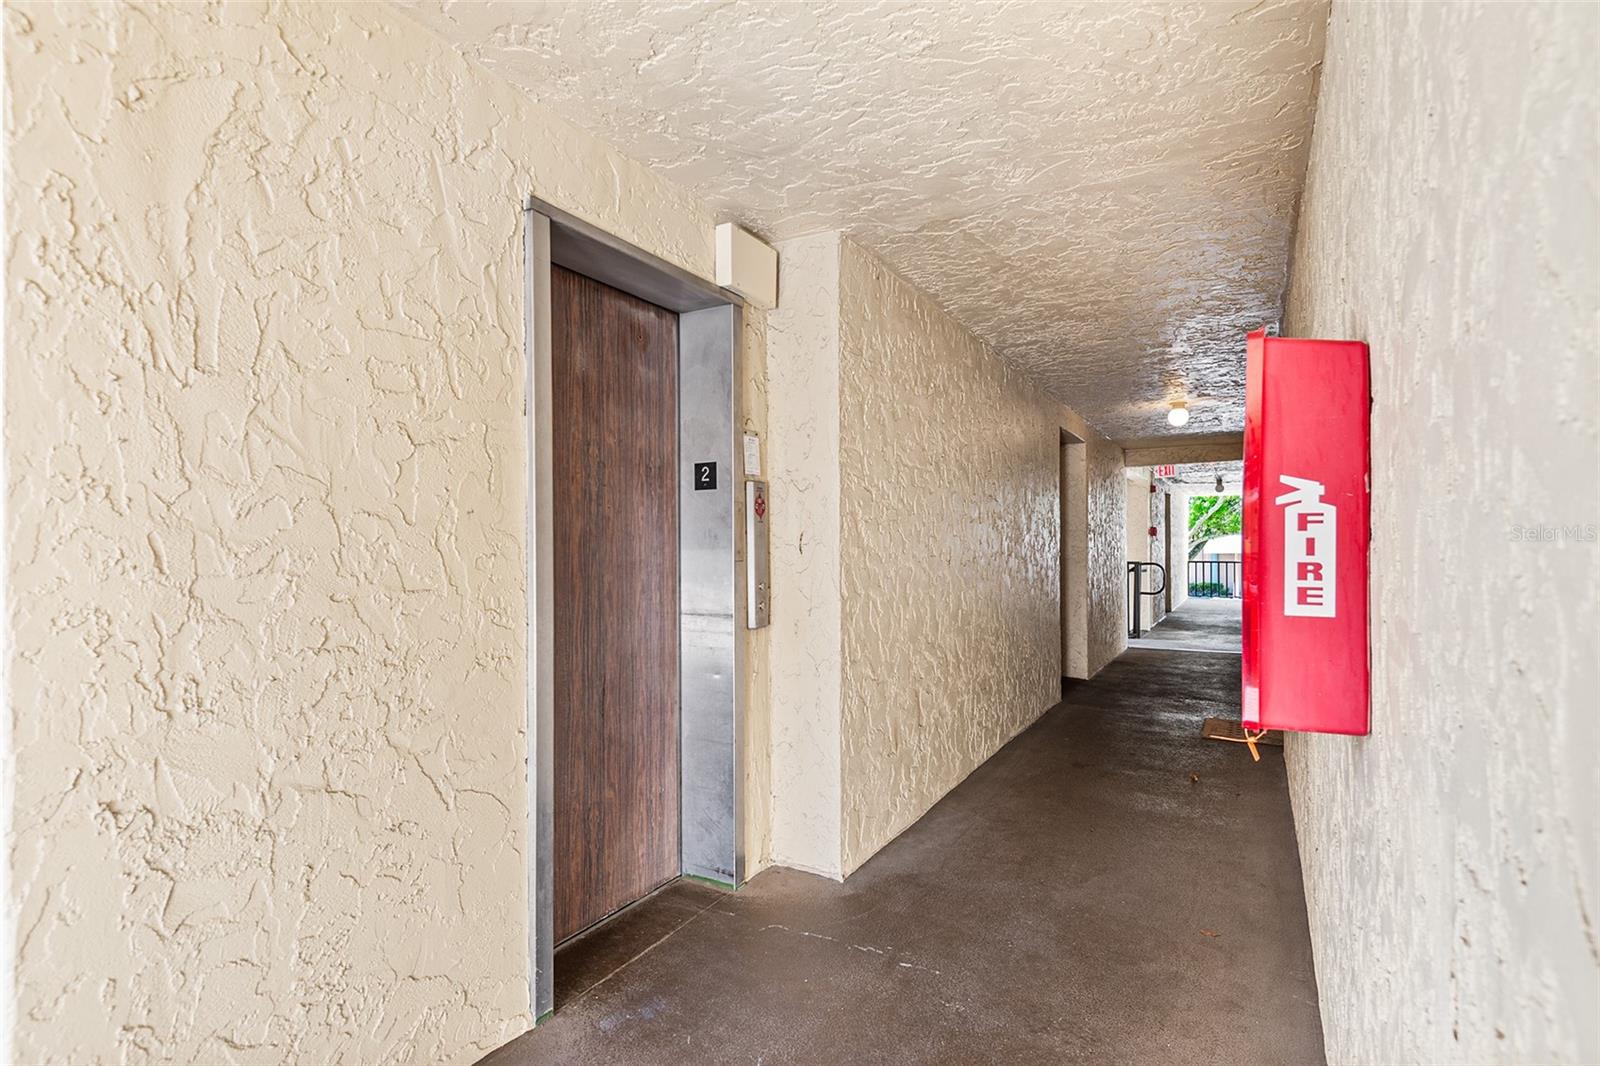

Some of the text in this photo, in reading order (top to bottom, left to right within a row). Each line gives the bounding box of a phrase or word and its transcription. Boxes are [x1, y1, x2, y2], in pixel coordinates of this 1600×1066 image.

[701, 466, 710, 481] 2
[1158, 465, 1175, 477] EXIT
[1297, 513, 1324, 606] FIRE
